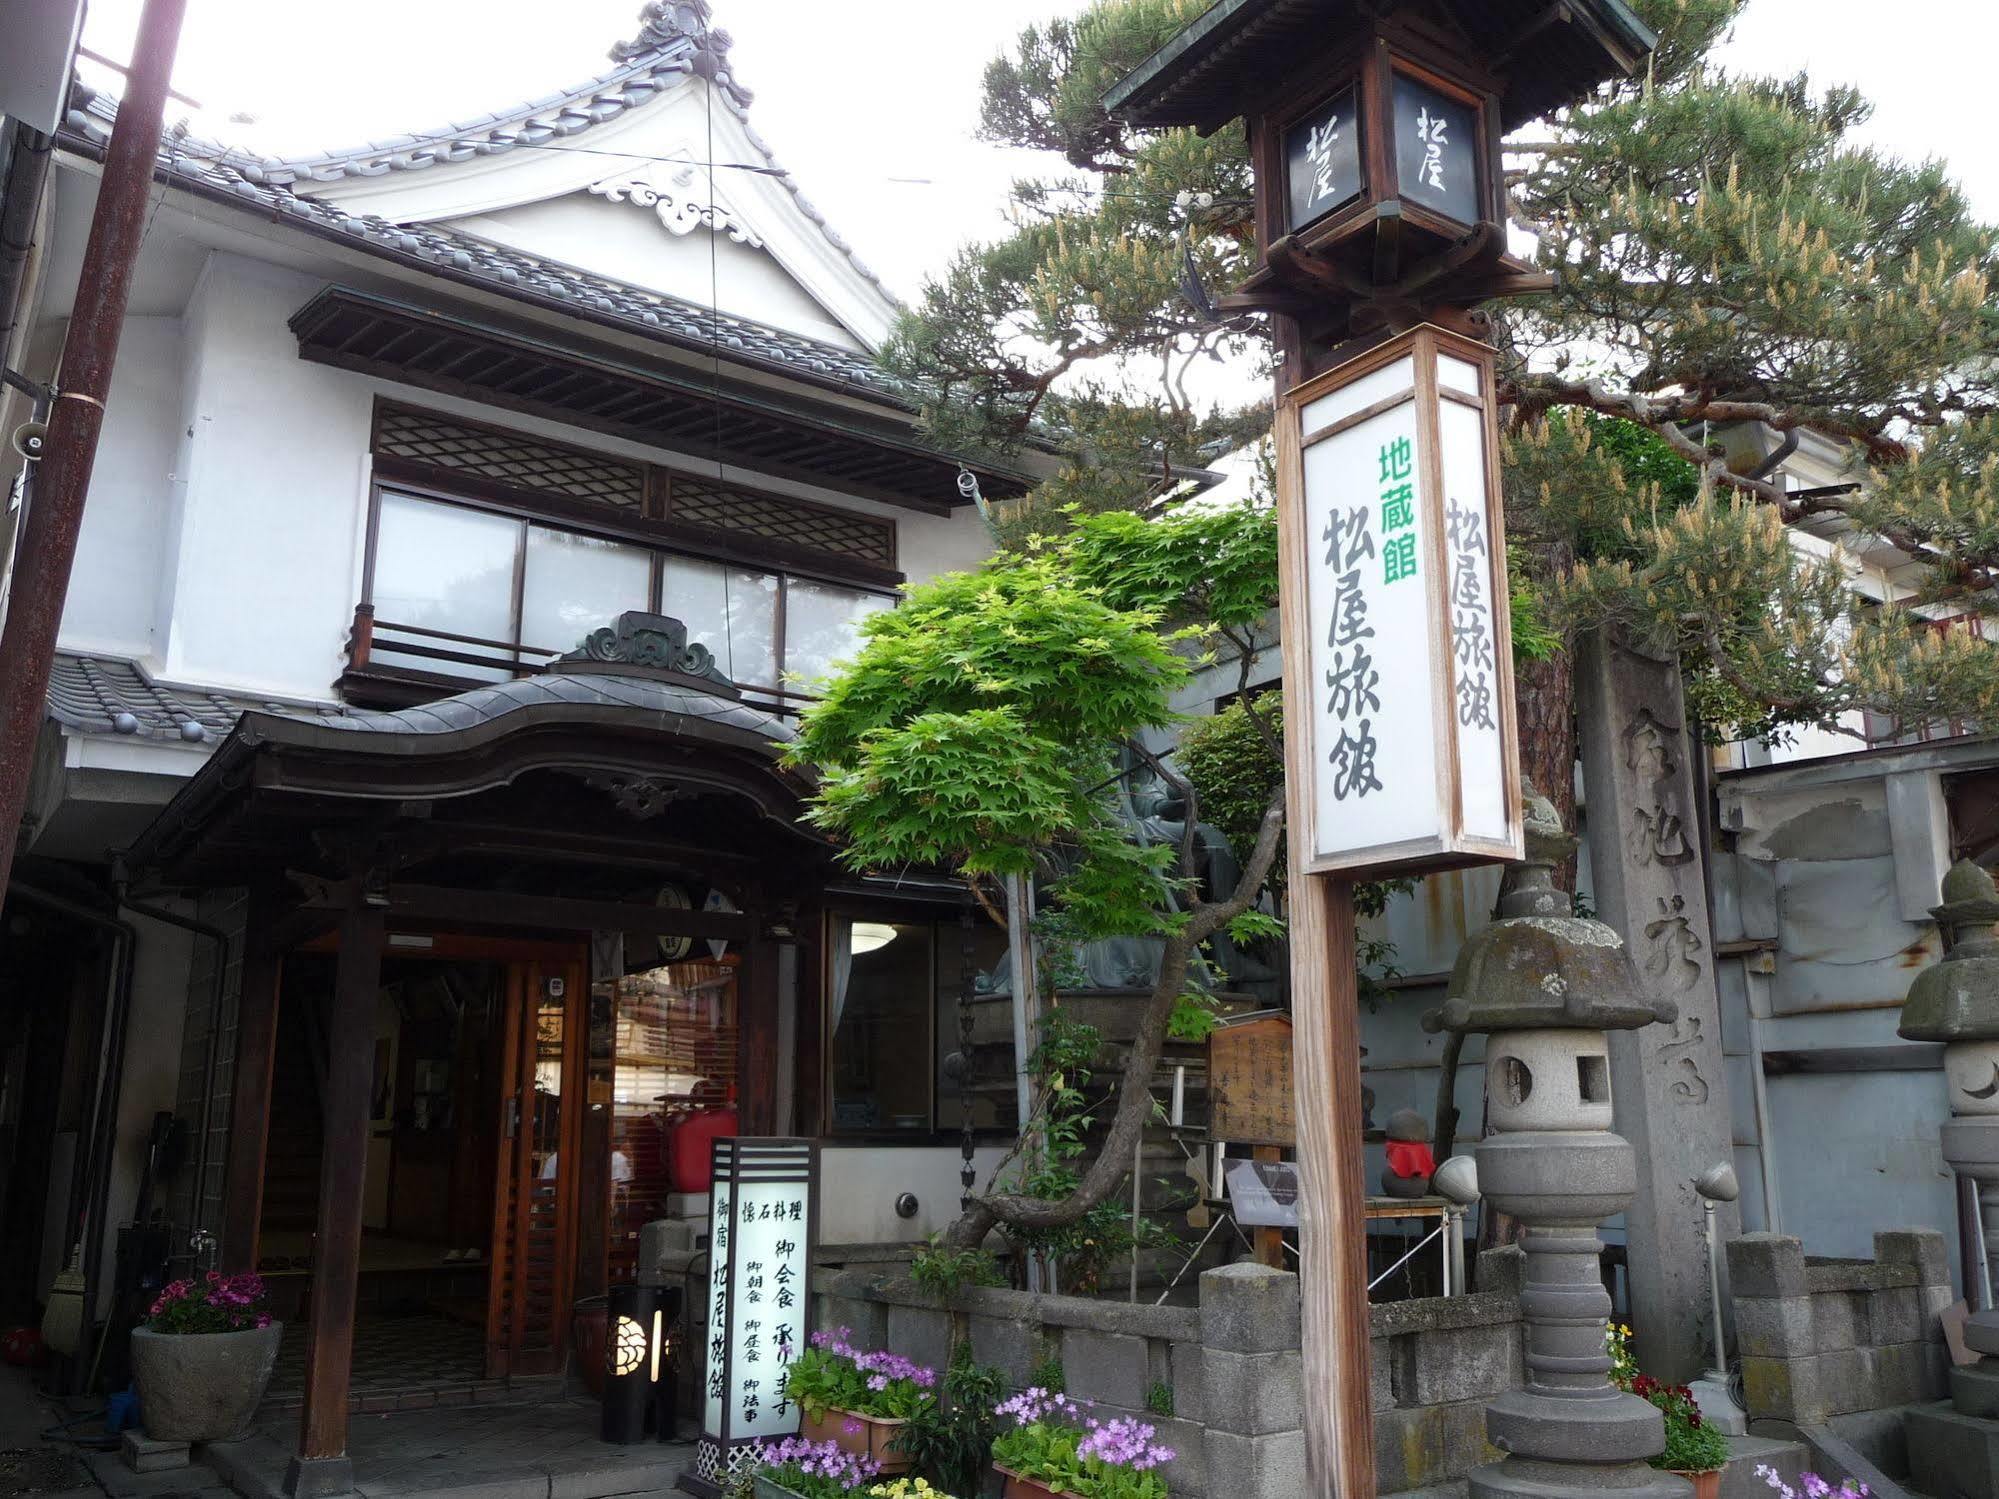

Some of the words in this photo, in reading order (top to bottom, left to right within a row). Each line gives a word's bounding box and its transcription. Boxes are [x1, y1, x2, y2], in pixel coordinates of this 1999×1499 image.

[1306, 115, 1338, 208] 松屋
[1417, 107, 1448, 192] 松屋
[1378, 436, 1418, 586] 地蔵館
[1322, 504, 1383, 801] 松屋旅館
[1446, 498, 1495, 730] 松屋旅館
[742, 1200, 802, 1223] 懐石料理
[772, 1239, 795, 1309] 御会食
